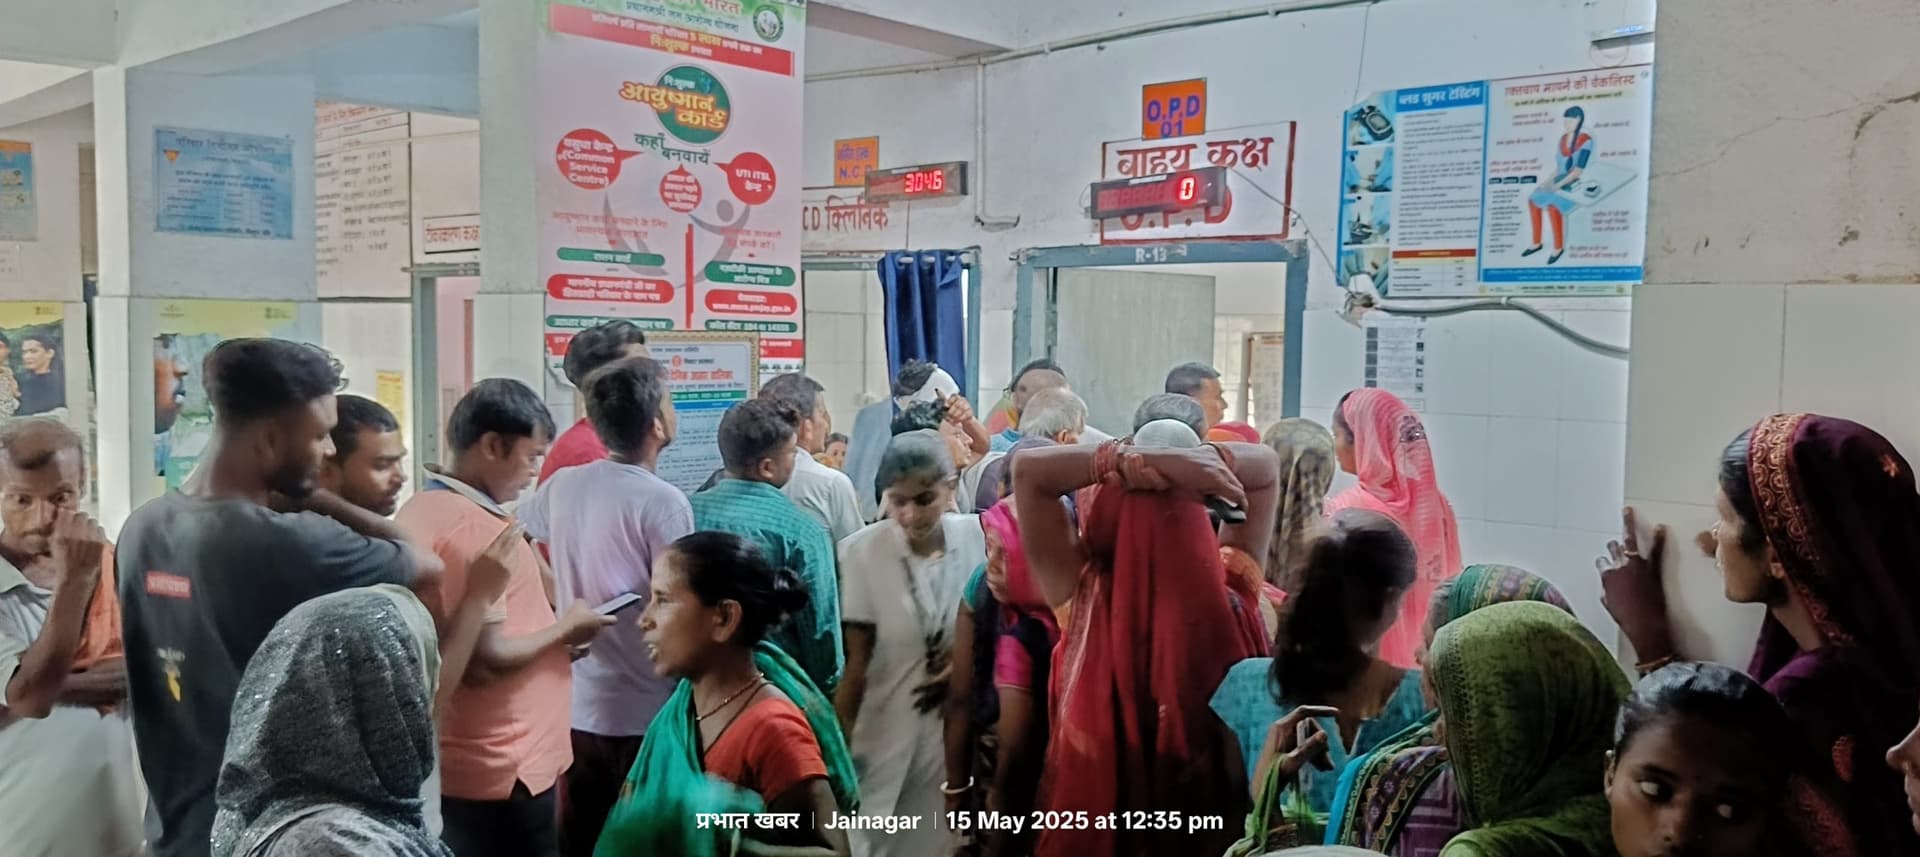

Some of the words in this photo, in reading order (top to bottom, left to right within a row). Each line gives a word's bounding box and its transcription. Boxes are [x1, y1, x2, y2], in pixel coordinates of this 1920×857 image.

[677, 109, 728, 130] कार्ड
[1147, 95, 1200, 121] O.P.D
[1160, 119, 1184, 138] 01
[1206, 136, 1275, 171] कक्ष
[569, 161, 609, 175] Service
[904, 170, 943, 193] 3046
[1179, 176, 1195, 200] 0
[802, 206, 821, 231] CD
